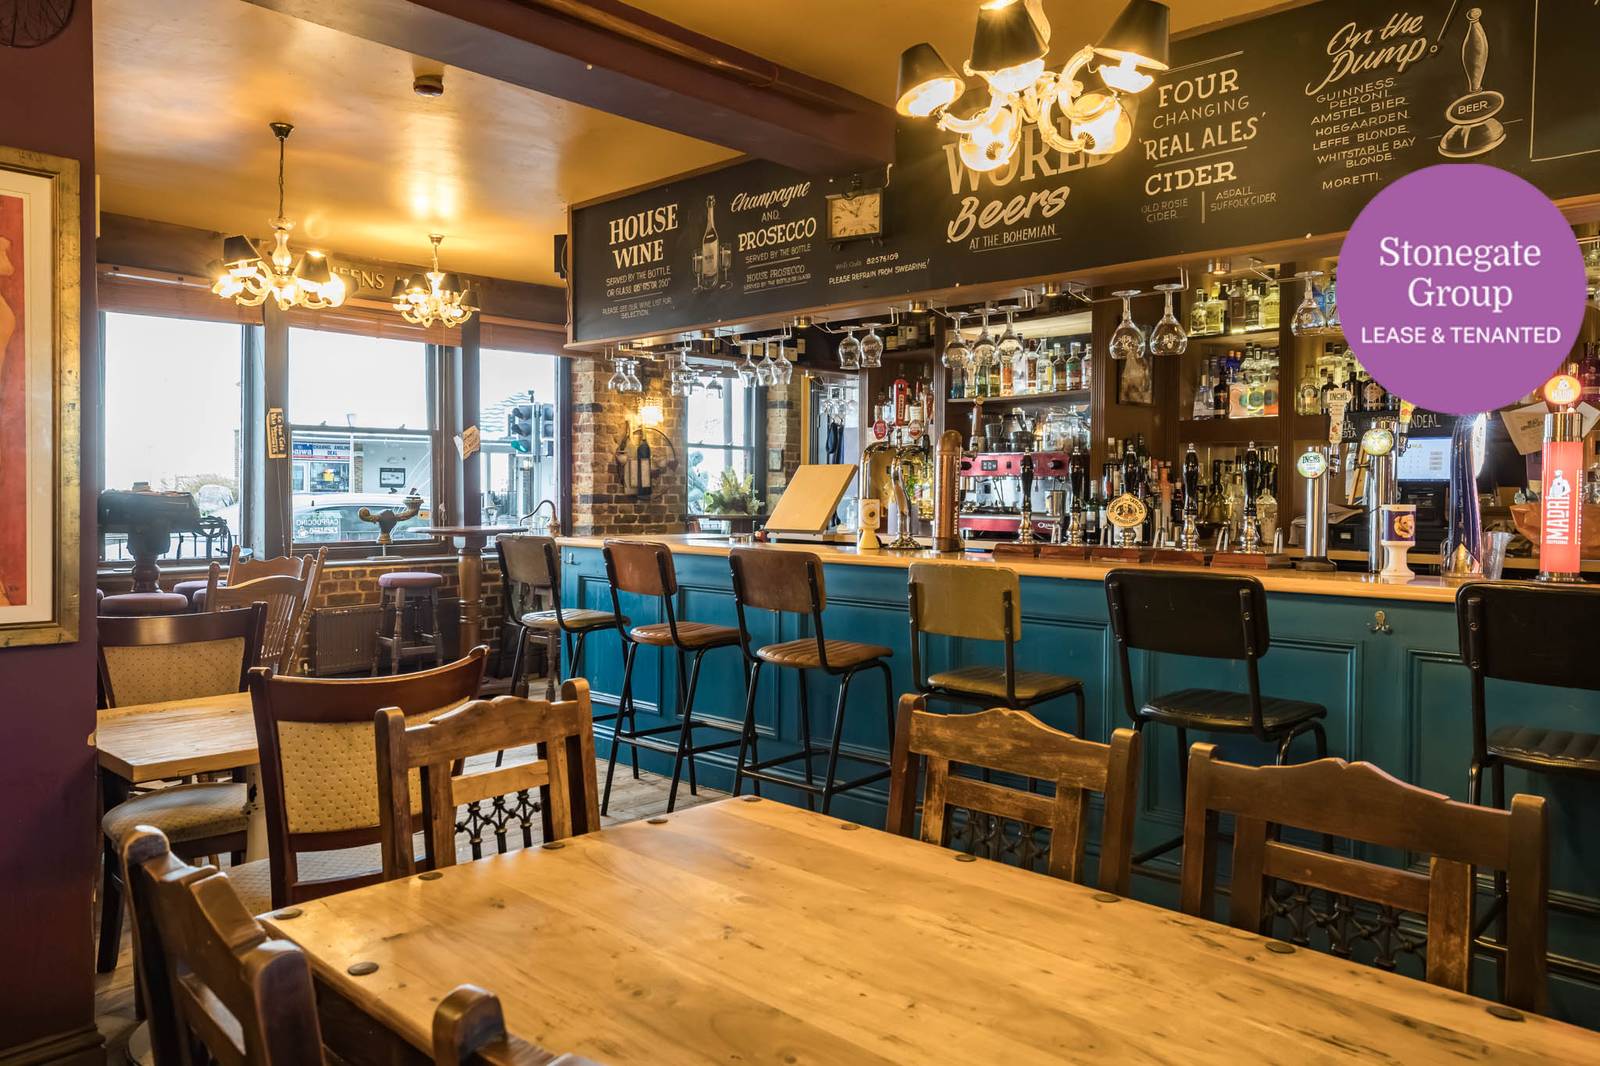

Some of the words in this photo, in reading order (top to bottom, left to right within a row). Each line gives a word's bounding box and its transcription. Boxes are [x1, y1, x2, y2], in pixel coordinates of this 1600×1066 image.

[1327, 22, 1373, 55] On
[1380, 12, 1423, 40] the
[1158, 68, 1239, 108] FOUR
[1153, 96, 1249, 129] CHANGING
[1311, 107, 1365, 125] AMSTEL
[1457, 100, 1488, 115] BEER
[1313, 136, 1350, 150] LEFFE
[1317, 142, 1389, 164] WHITSTABLE
[1393, 136, 1416, 149] BAY
[1145, 161, 1237, 196] CIDER
[731, 181, 810, 213] Champagne
[1141, 203, 1160, 214] OLD
[1162, 198, 1188, 211] ROSIE
[1210, 198, 1250, 212] SUFFOLK
[1252, 192, 1277, 205] CIDER
[609, 203, 679, 245] HOUSE
[947, 186, 1070, 243] Beers
[1146, 210, 1178, 223] CIDER
[738, 217, 817, 252] PROSECCO
[969, 236, 980, 250] AT
[983, 233, 999, 246] THE
[1003, 224, 1056, 243] BOHEMIAN
[613, 240, 663, 269] WINE
[745, 252, 768, 264] SERVED
[770, 250, 779, 258] BY
[780, 247, 790, 256] THE
[791, 243, 812, 254] BOTTLE
[606, 274, 627, 287] SERVED
[628, 273, 635, 283] BY
[636, 271, 647, 280] THE
[648, 265, 671, 278] BOTTLE
[746, 271, 768, 282] HOUSE
[770, 264, 805, 278] PROSECCO
[829, 275, 850, 284] PLEASE
[852, 271, 876, 280] REFRAIN
[877, 267, 893, 276] FROM
[607, 288, 616, 297] OR
[616, 285, 631, 295] GLASS
